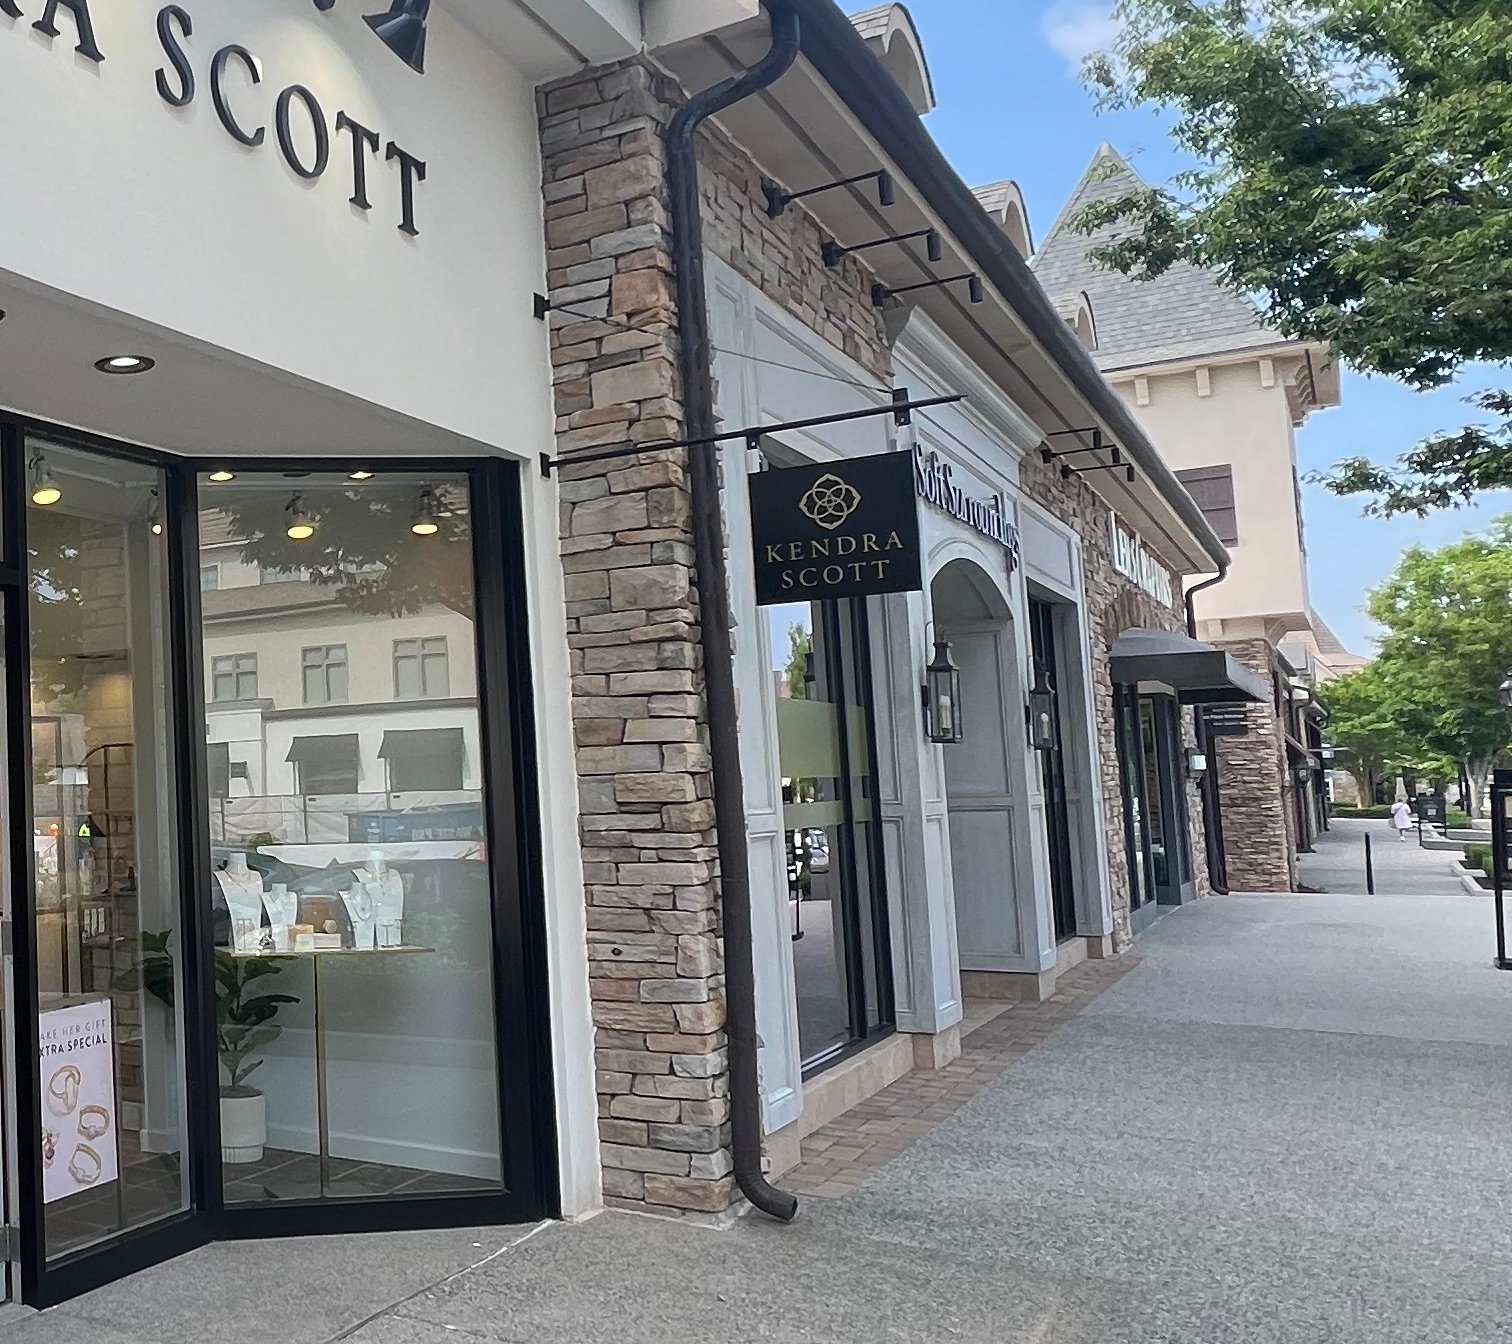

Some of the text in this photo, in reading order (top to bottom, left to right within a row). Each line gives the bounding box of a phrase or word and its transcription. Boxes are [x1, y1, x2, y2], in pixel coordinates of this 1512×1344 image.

[154, 4, 428, 238] SCOTT
[765, 530, 904, 563] KENDRA
[781, 559, 890, 589] SCOTT
[40, 1018, 106, 1041] AKE HER GIFT
[39, 1032, 107, 1058] XTRA SPECIAL
